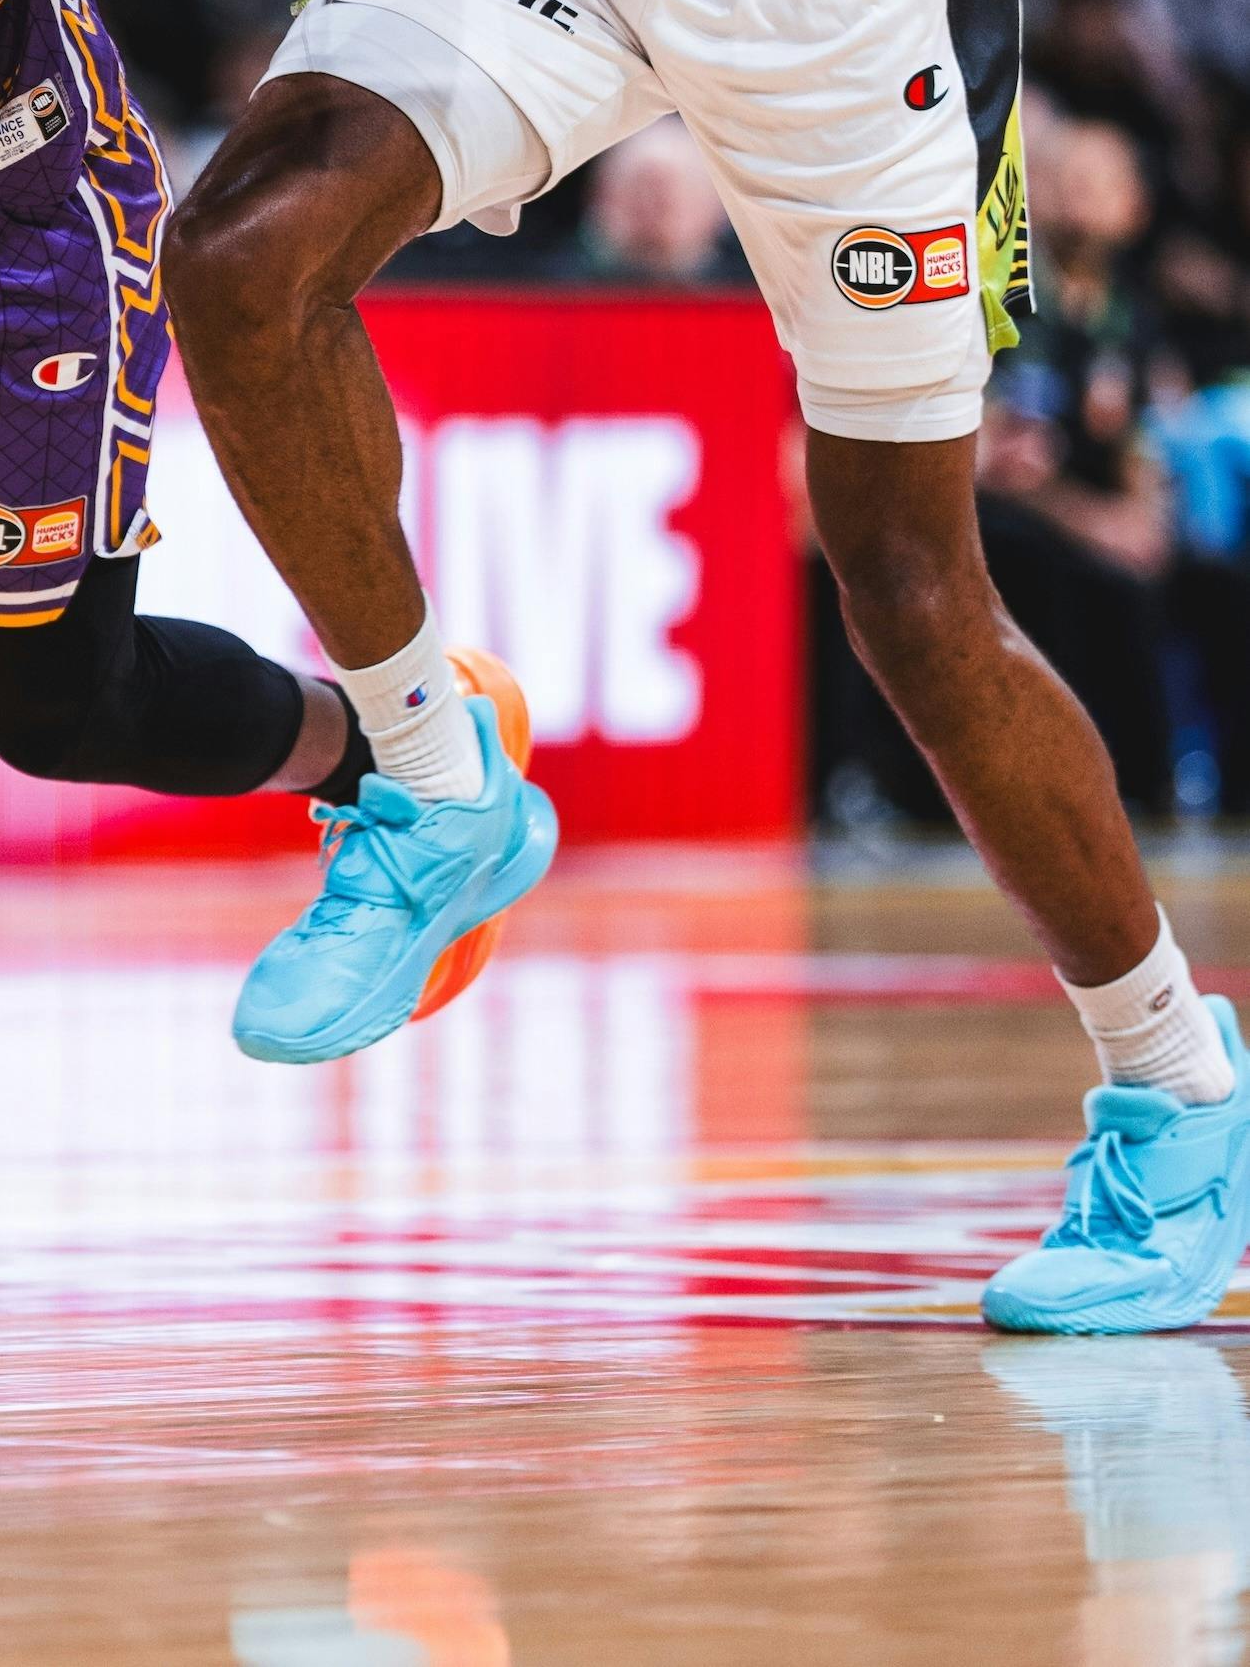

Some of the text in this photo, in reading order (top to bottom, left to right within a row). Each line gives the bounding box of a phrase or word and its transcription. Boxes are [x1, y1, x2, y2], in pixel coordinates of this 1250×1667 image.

[33, 93, 53, 110] NBL
[849, 250, 960, 285] NBL HUNGRY
[36, 521, 76, 534] HUNGRY
